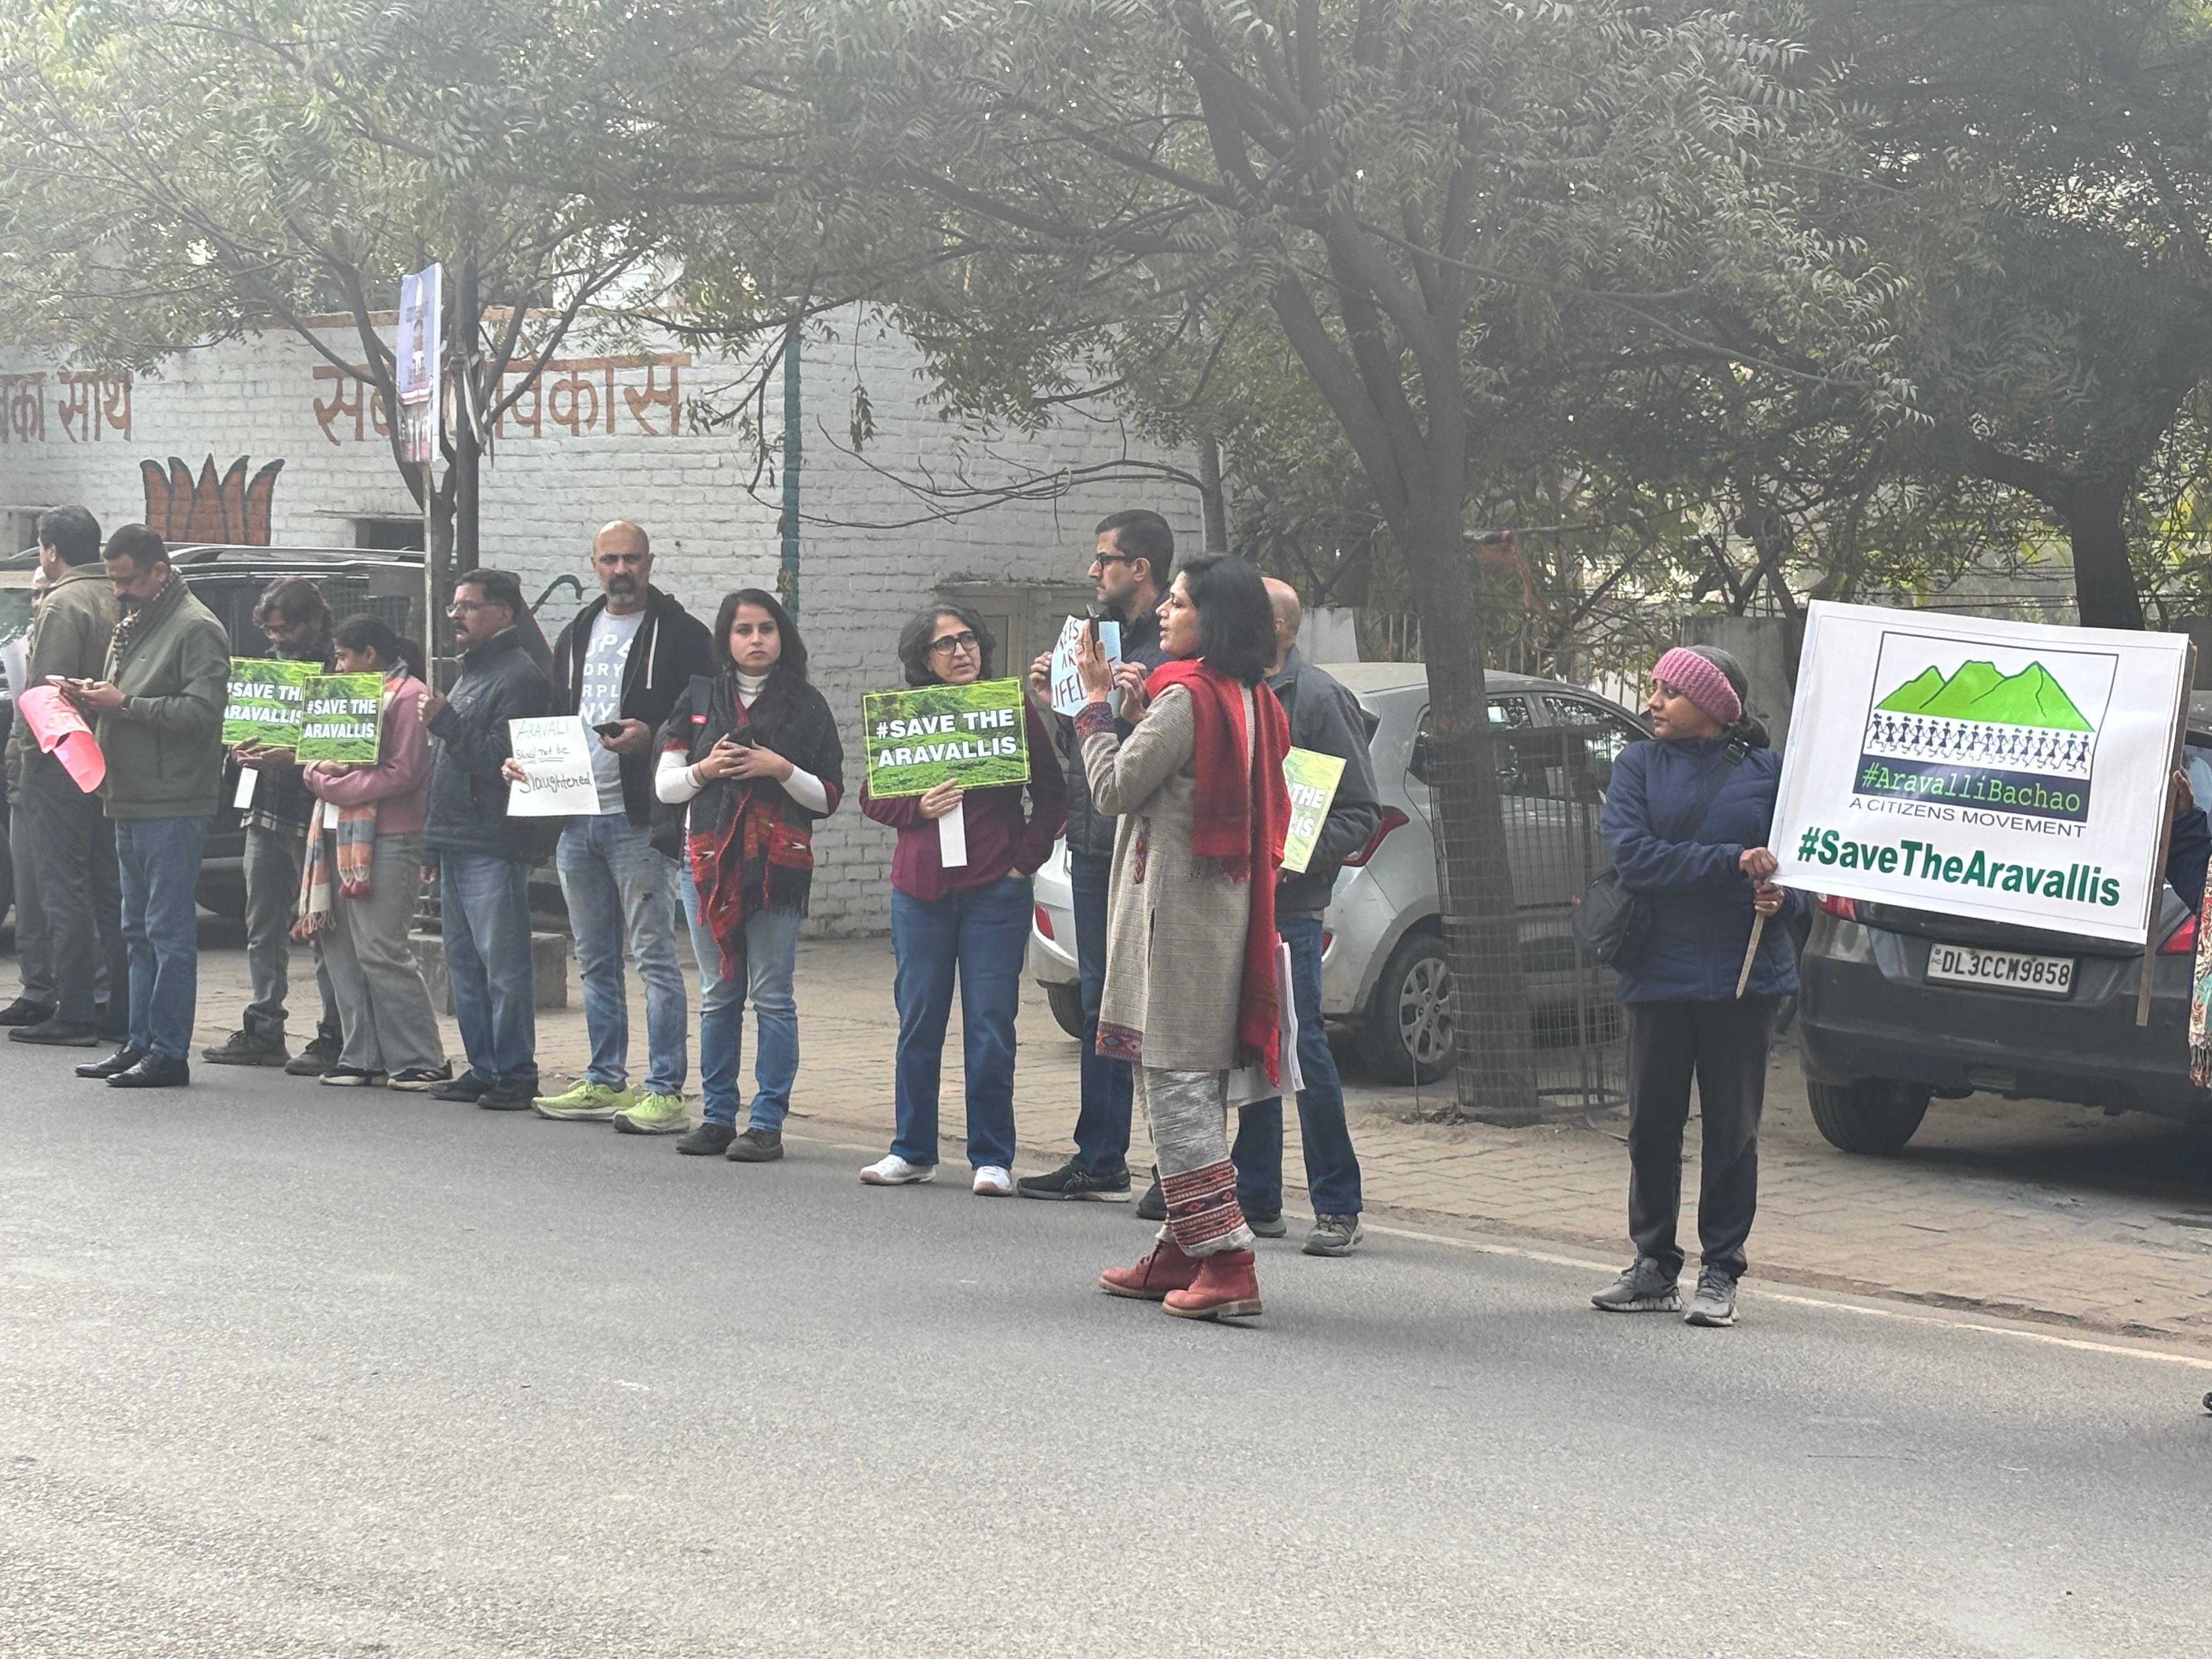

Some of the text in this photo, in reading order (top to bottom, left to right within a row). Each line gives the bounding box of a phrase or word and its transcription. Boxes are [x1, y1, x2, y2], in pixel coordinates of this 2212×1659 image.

[57, 369, 134, 443] साथ
[583, 663, 624, 678] DRY
[1062, 648, 1076, 671] AR
[279, 685, 303, 702] TH
[306, 699, 377, 714] #SAVE THE
[303, 723, 375, 738] ARAVALLIS
[876, 708, 1015, 740] #SAVE THE
[557, 743, 571, 755] be
[878, 736, 1017, 768] ARAVALLIS
[1290, 782, 1326, 809] THE
[1862, 762, 2081, 813] #AravalliBachao
[1849, 798, 2087, 838] A CITIZENS MOVEMENT
[1797, 827, 2120, 906] #SaveTheAravallis
[1941, 950, 2070, 986] DL3CCM9858
